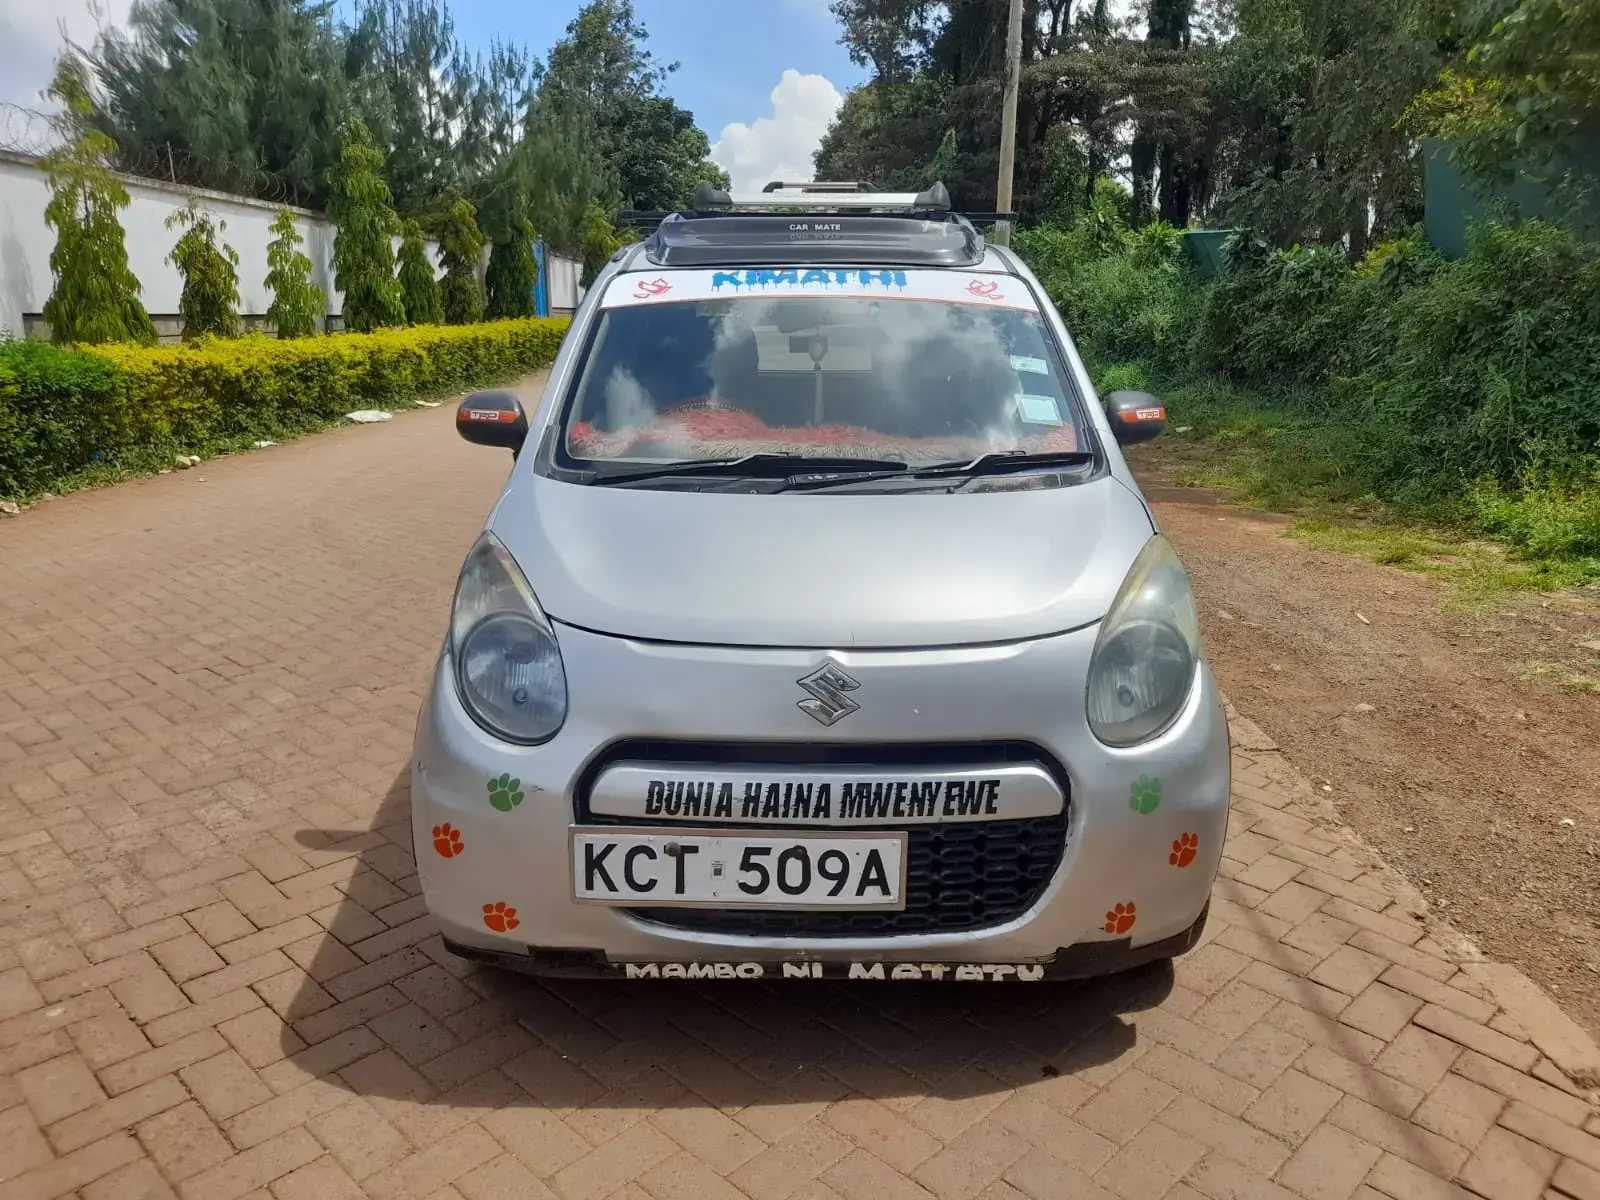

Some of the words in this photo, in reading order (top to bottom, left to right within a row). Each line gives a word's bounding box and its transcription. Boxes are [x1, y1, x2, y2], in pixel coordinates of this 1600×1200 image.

[789, 223, 809, 231] CAR
[814, 223, 841, 231] MATE
[711, 269, 907, 292] KIMATHI
[645, 780, 733, 817] DUNIA
[740, 782, 831, 818] HAINA
[839, 779, 1001, 818] MWENYEWE
[584, 842, 700, 895] KCT
[737, 845, 891, 897] 509A
[625, 962, 764, 980] MAMBO
[782, 962, 823, 980] NI
[848, 962, 1045, 982] MATATU
